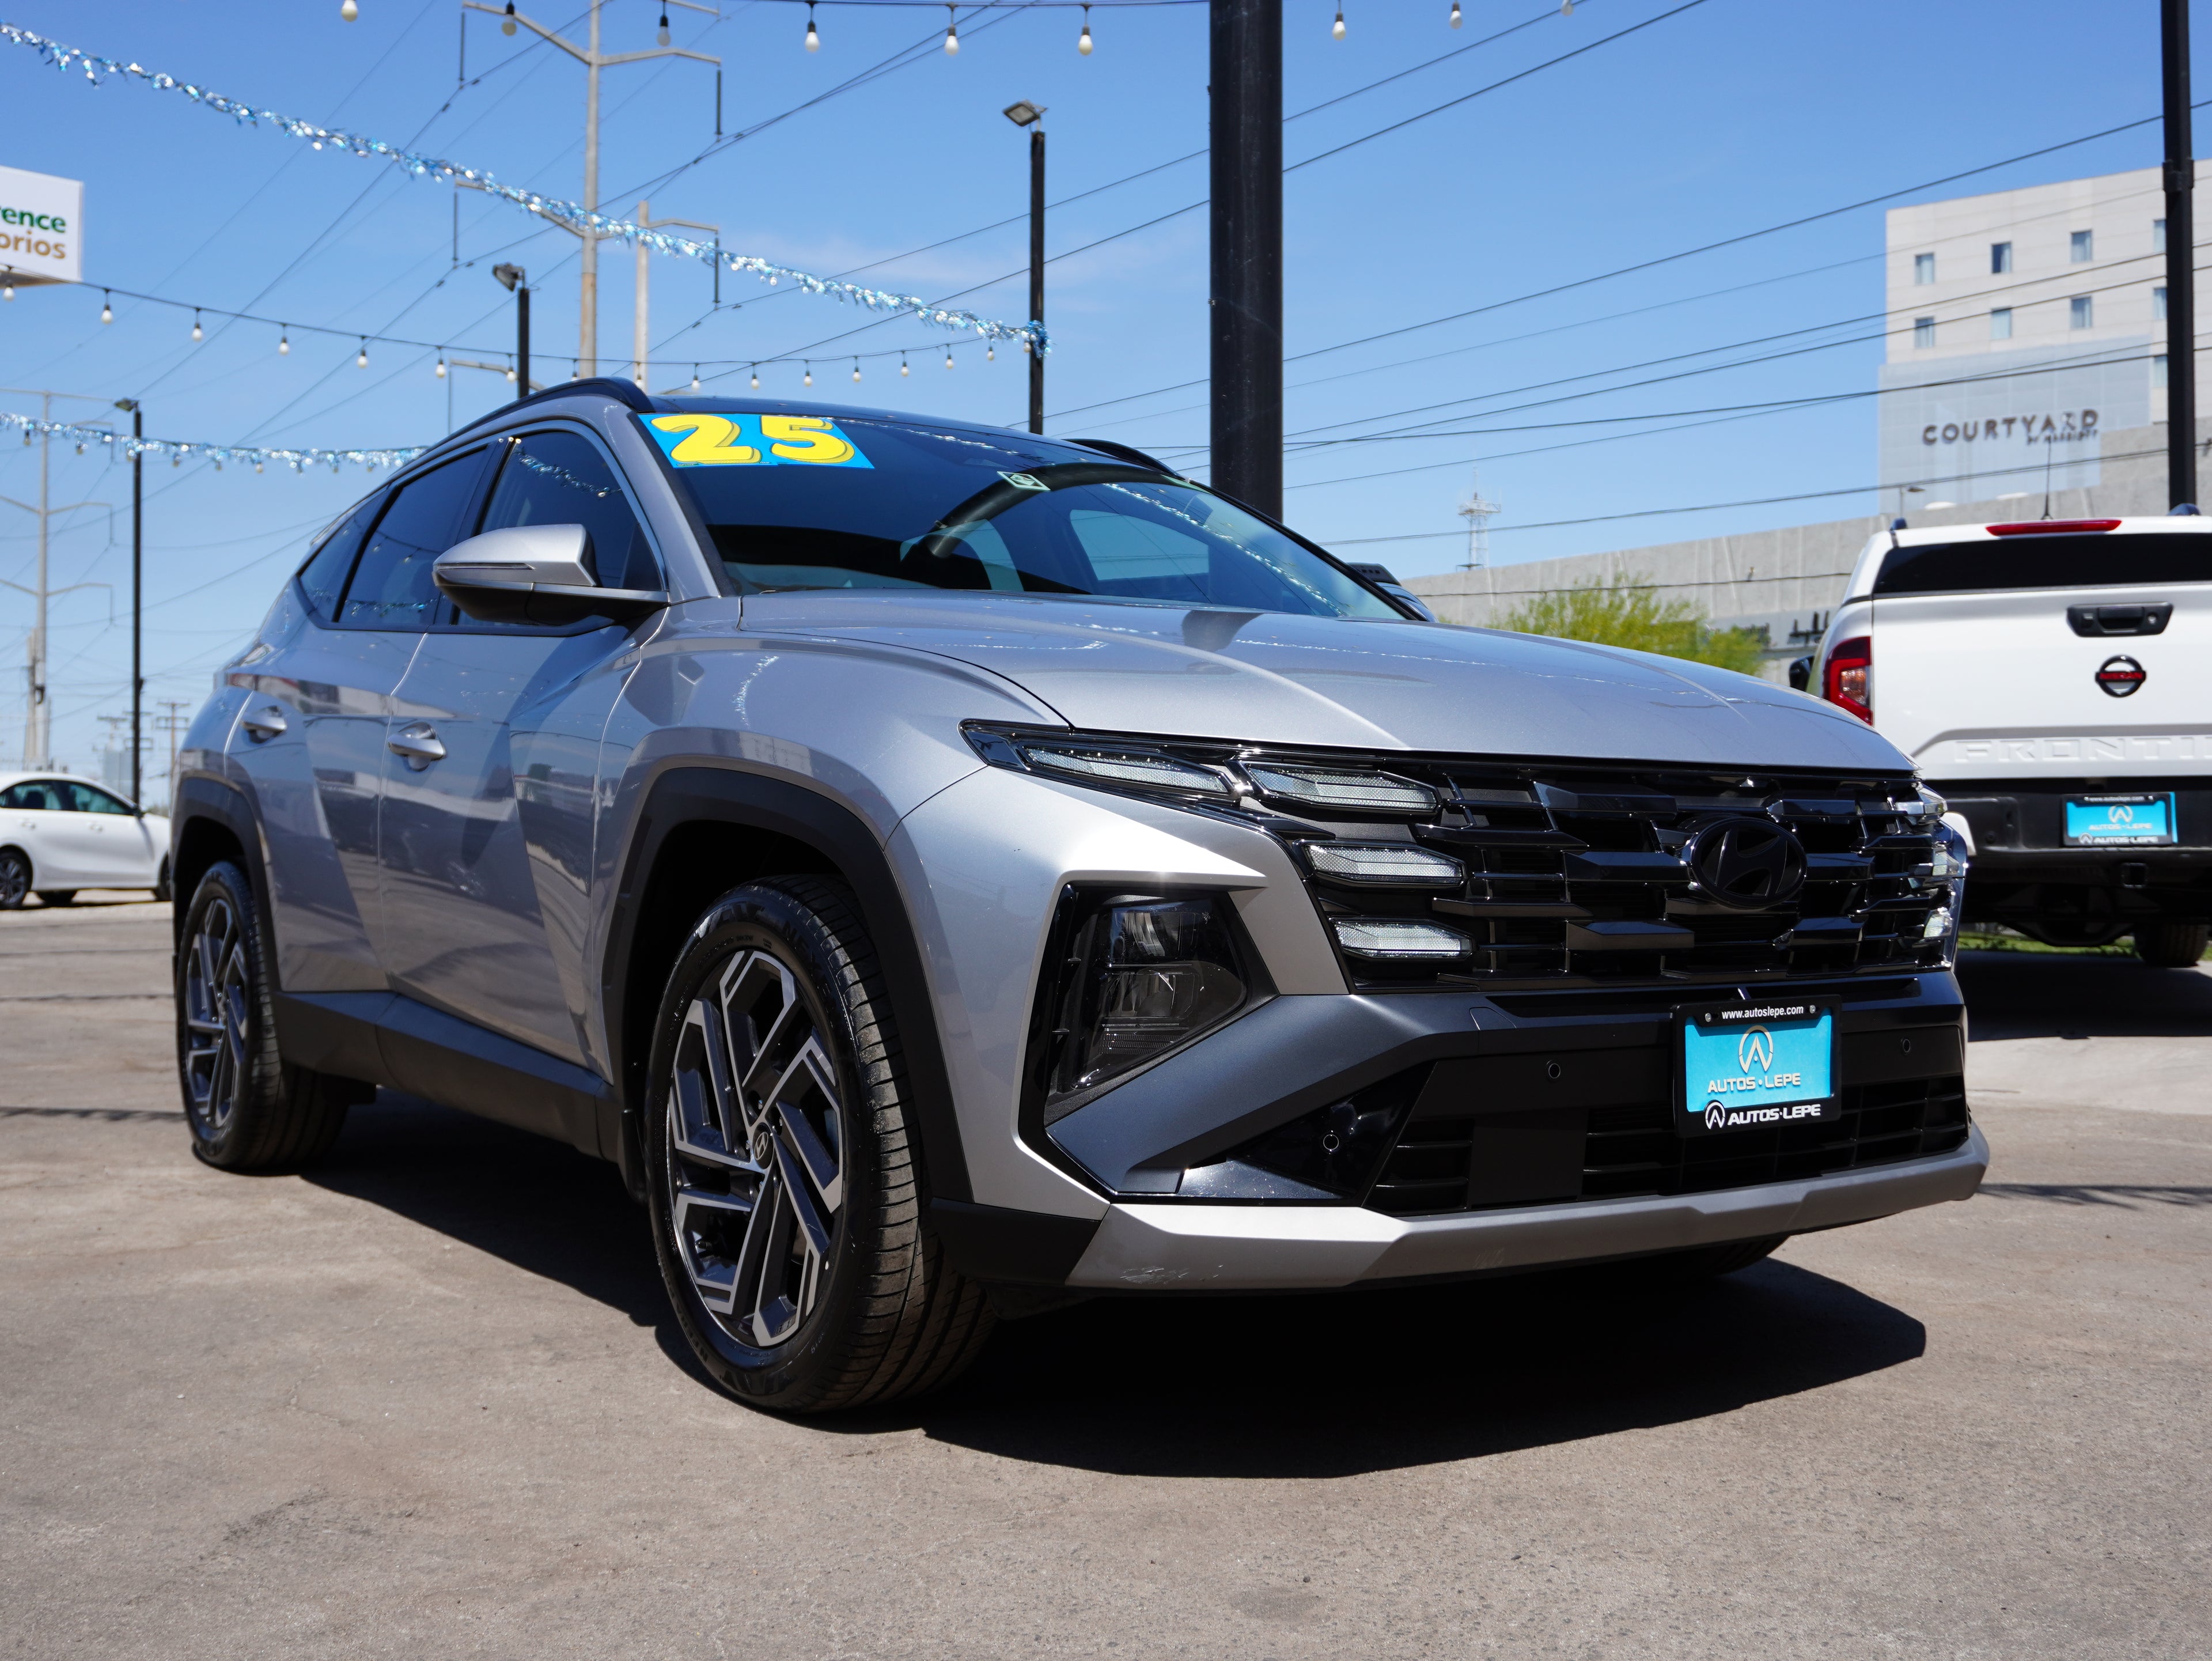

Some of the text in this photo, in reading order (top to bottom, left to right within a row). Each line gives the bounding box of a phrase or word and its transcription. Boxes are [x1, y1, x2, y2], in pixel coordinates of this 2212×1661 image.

[0, 206, 66, 233] ence
[651, 414, 855, 464] 25
[1922, 409, 2099, 444] COURTYARD
[1955, 737, 2212, 762] FRONTI
[1721, 1006, 1804, 1019] www.autoslepe.com
[1707, 1072, 1801, 1093] AUTOS LEPE
